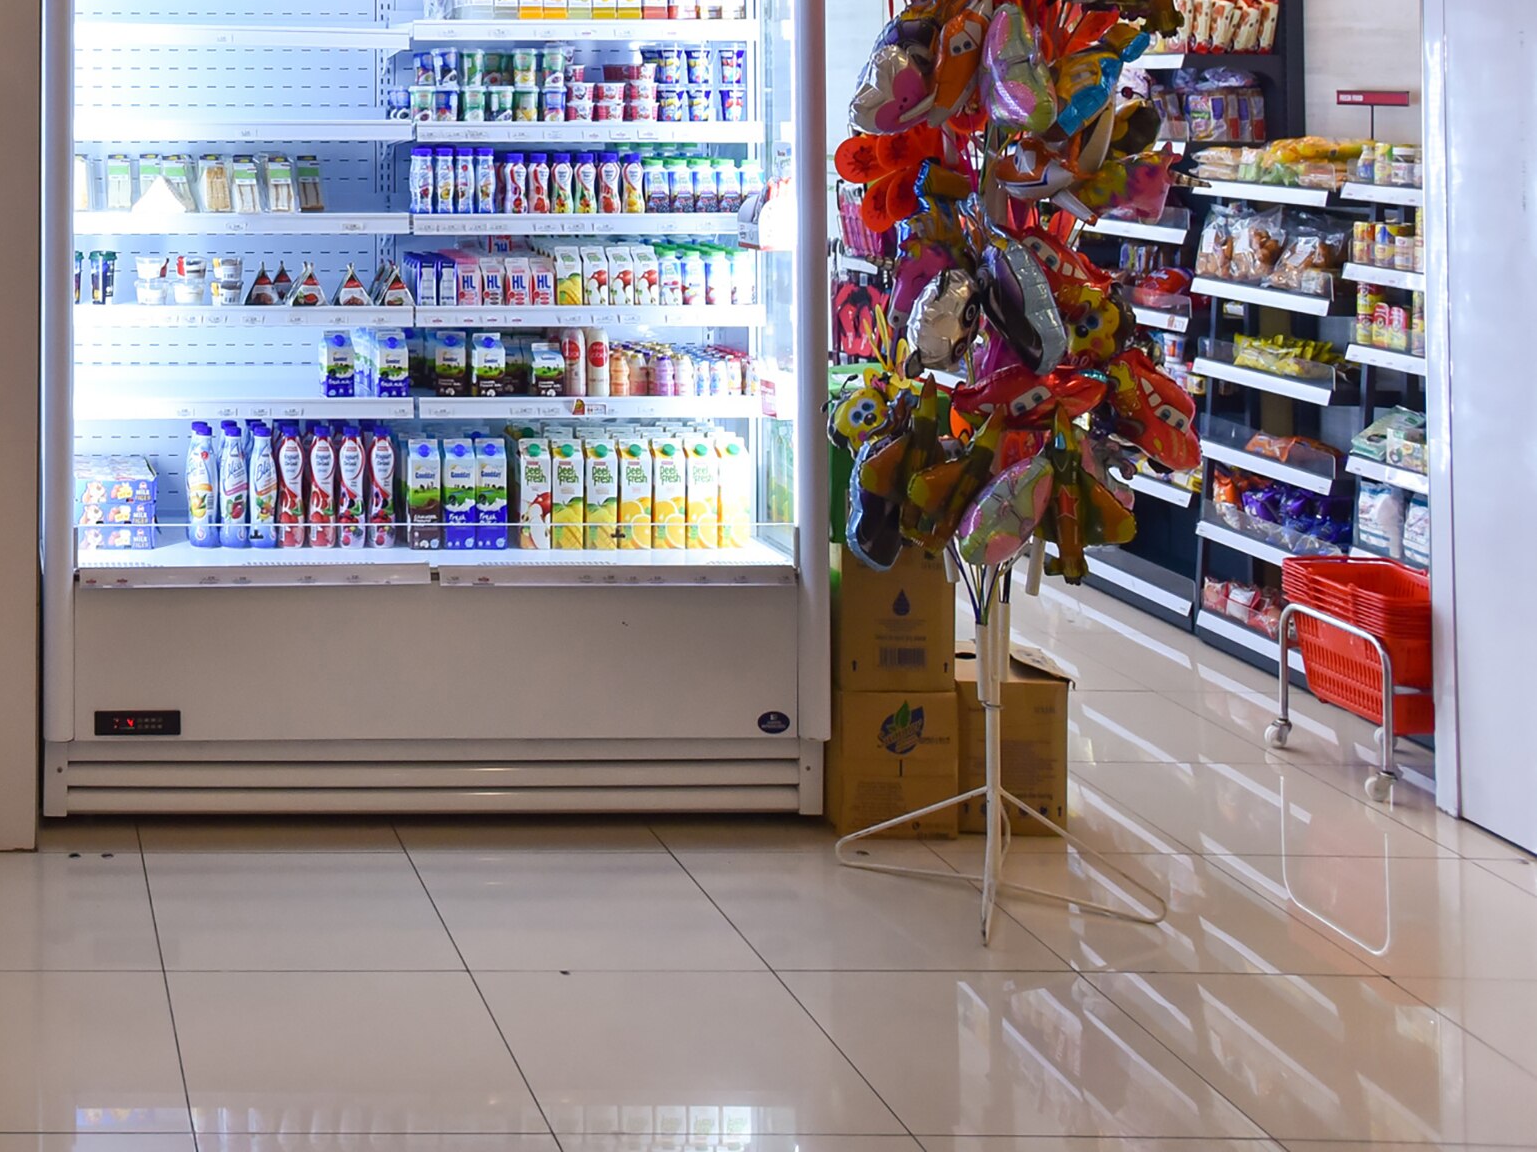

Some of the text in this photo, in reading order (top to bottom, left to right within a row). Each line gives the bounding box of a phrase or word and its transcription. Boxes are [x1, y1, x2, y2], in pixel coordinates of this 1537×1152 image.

[462, 275, 476, 290] HL
[486, 274, 501, 289] HL
[512, 275, 526, 289] HL
[537, 274, 551, 289] HL
